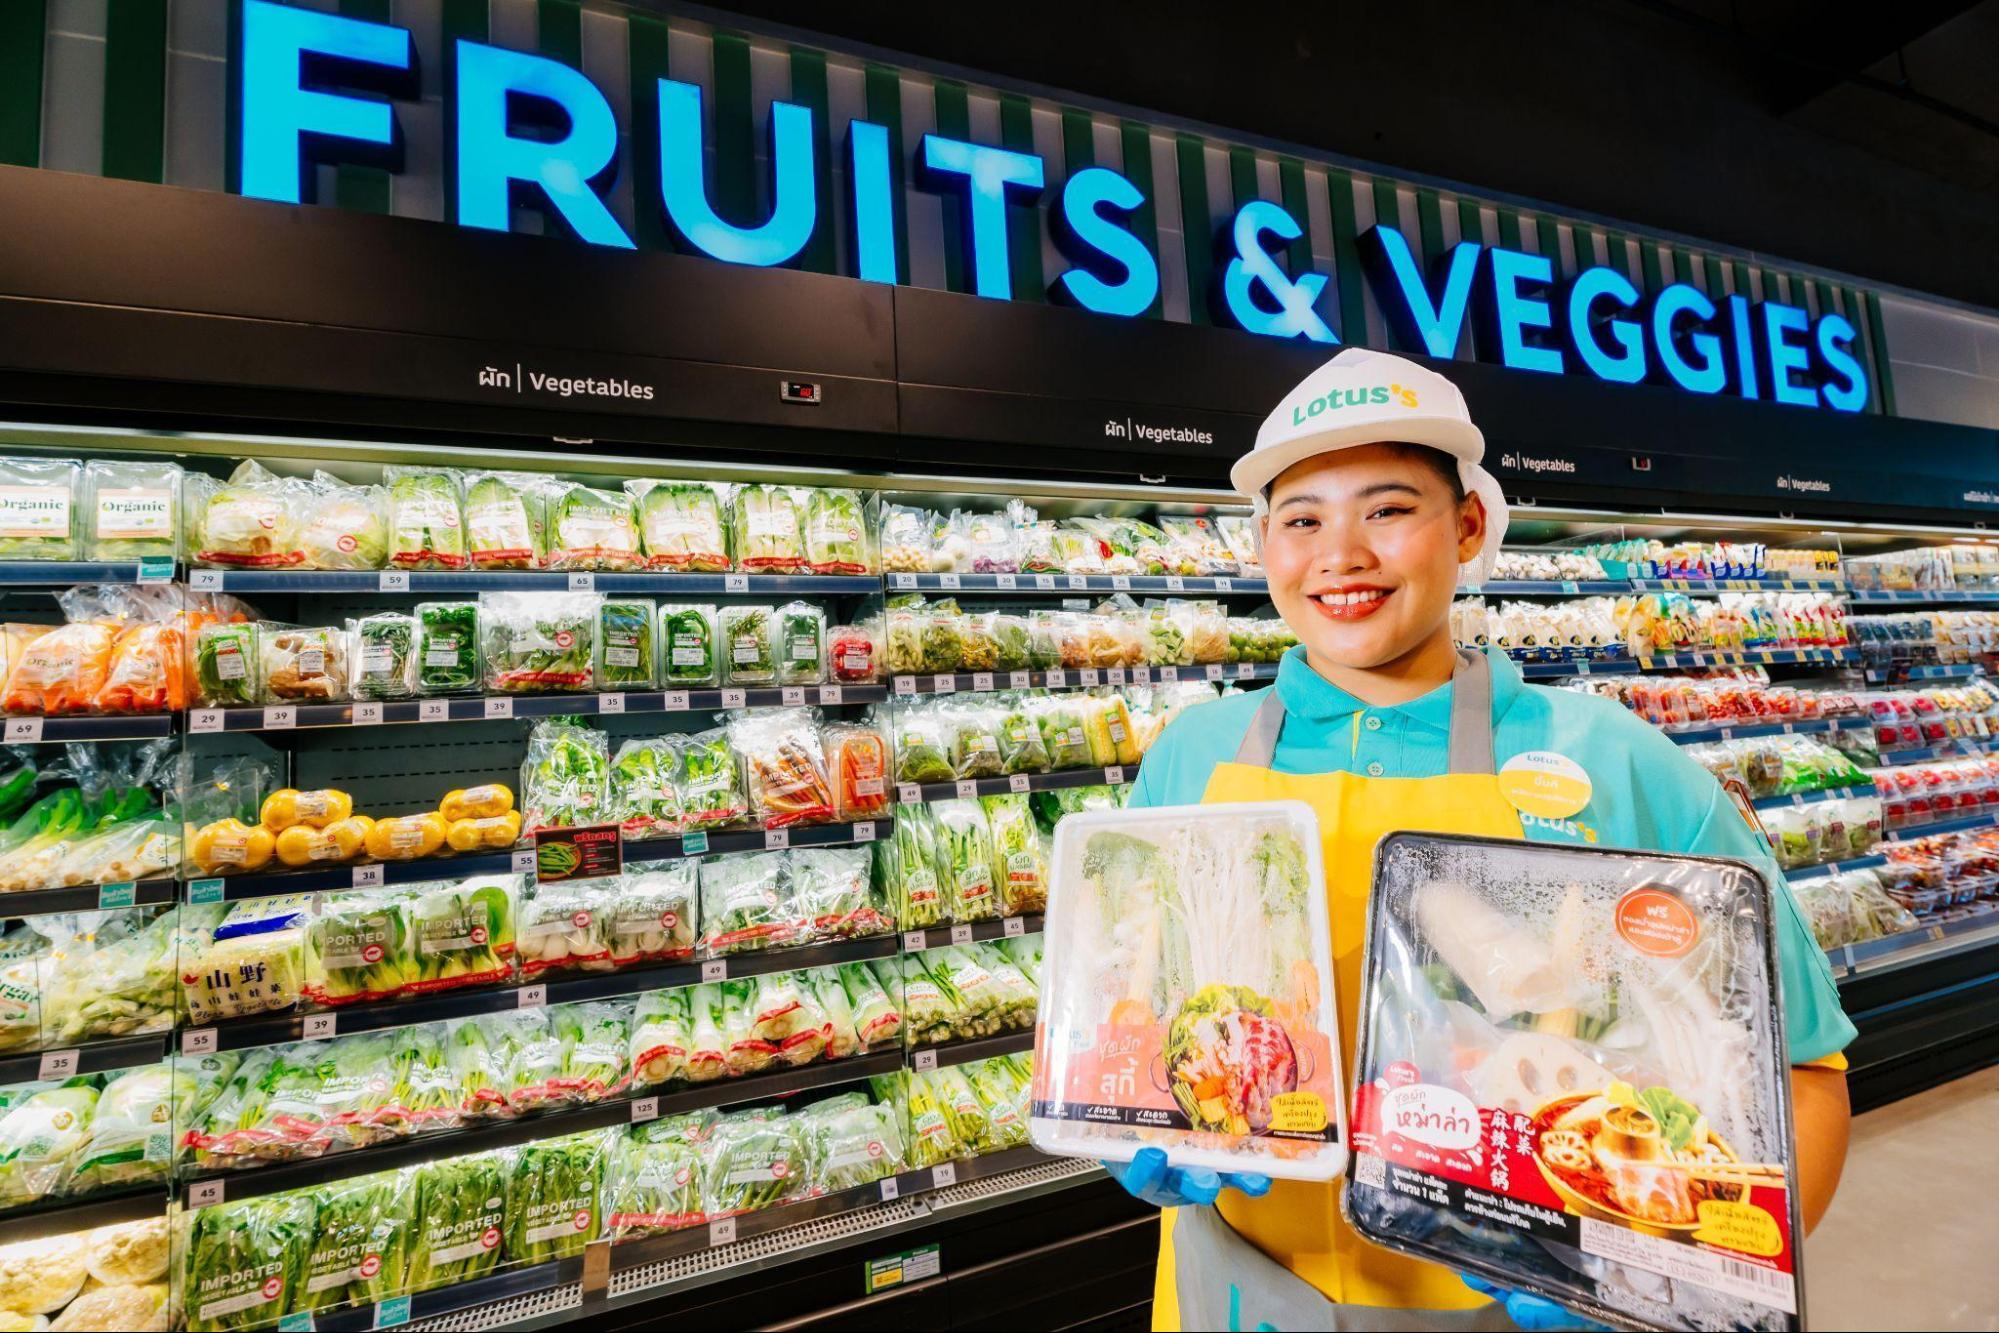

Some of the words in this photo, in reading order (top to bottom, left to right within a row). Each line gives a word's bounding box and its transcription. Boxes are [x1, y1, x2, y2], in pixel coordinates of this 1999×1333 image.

[242, 0, 1157, 315] FRUITS
[1225, 202, 1339, 343] &
[1377, 226, 1867, 411] VEGGIES
[479, 366, 511, 388] ผัก
[530, 372, 654, 400] Vegetables
[1292, 383, 1419, 427] Lotus's
[1105, 420, 1125, 437] ผัก
[1136, 424, 1213, 444] Vegetables
[1502, 454, 1516, 467] ผัก
[1522, 457, 1575, 472] Vegetables
[1792, 479, 1830, 492] Vegetables
[102, 500, 165, 512] Organic
[494, 702, 505, 710] 39
[607, 698, 617, 706] 35
[202, 715, 215, 723] 29
[275, 712, 287, 720] 39
[17, 725, 32, 733] 69
[1520, 813, 1598, 843] otus's
[363, 872, 375, 880] 38
[326, 930, 386, 946] PORTED
[206, 961, 267, 990] 山野
[528, 991, 539, 999] 49
[314, 1021, 328, 1029] 39
[194, 1036, 208, 1045] 55
[1099, 1034, 1141, 1062] ชุดผัก
[54, 1059, 67, 1068] 35
[1100, 1057, 1139, 1104] สุกี้
[638, 1104, 652, 1112] 125
[1396, 1103, 1470, 1134] หม่าล่า
[731, 1151, 790, 1163] IMPORTED
[201, 1188, 215, 1197] 45
[1422, 1187, 1427, 1199] 1
[527, 1197, 593, 1218] IMPORTED
[429, 1212, 503, 1241] IMPORTED
[718, 1226, 729, 1234] 49
[310, 1240, 387, 1265] IMPORTED
[201, 1261, 284, 1292] IMPORTED
